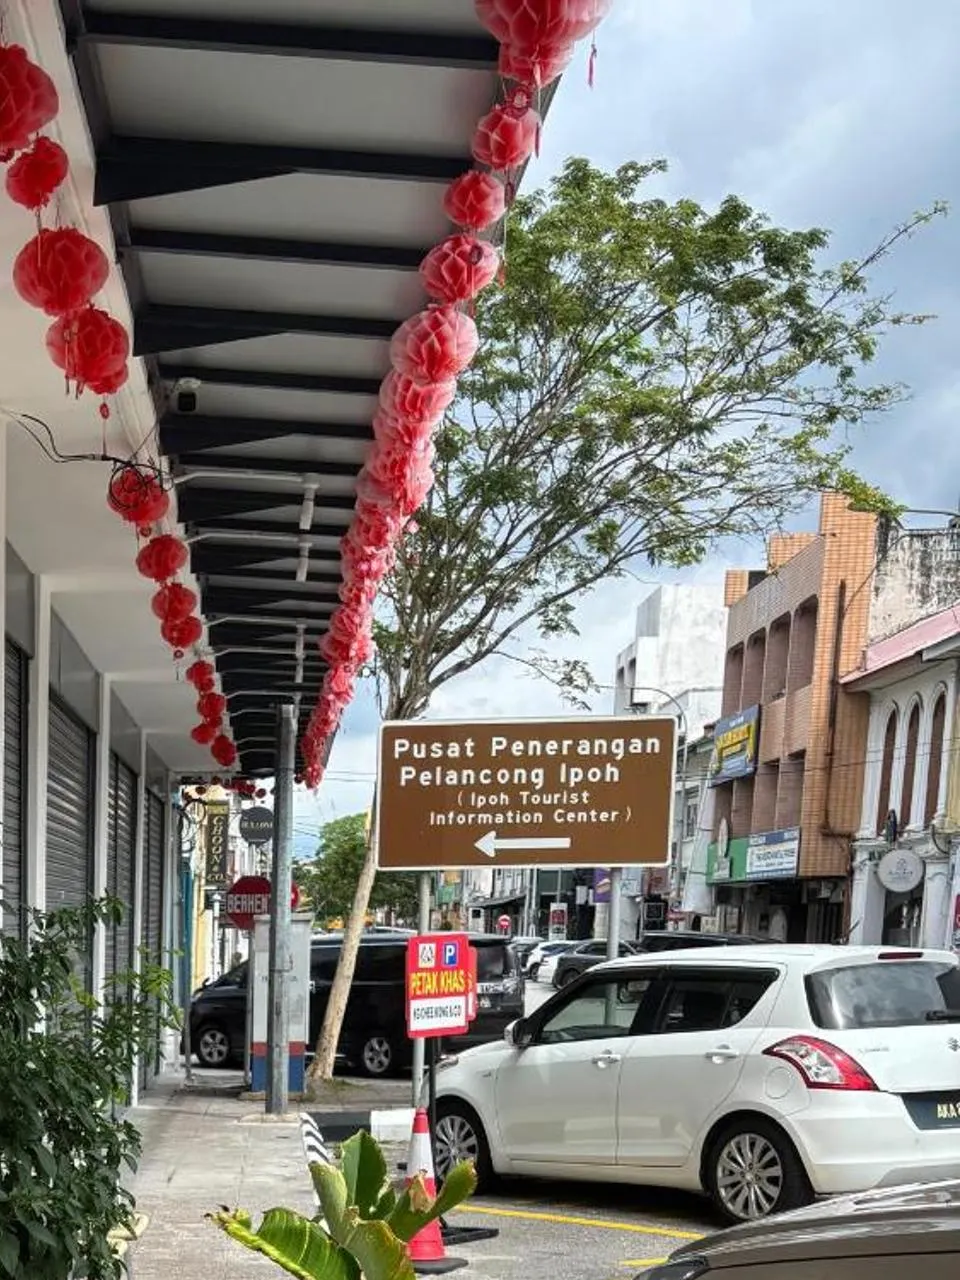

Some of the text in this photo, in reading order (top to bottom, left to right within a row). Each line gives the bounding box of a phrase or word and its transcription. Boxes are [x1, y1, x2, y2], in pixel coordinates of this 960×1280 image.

[394, 737, 660, 760] Pusat Penerangan
[400, 763, 619, 789] Pelancong Ipoh
[520, 790, 590, 805] Tourist
[430, 811, 543, 825] Information
[227, 893, 271, 914] BERHEN
[410, 970, 465, 996] PETAK KHAS
